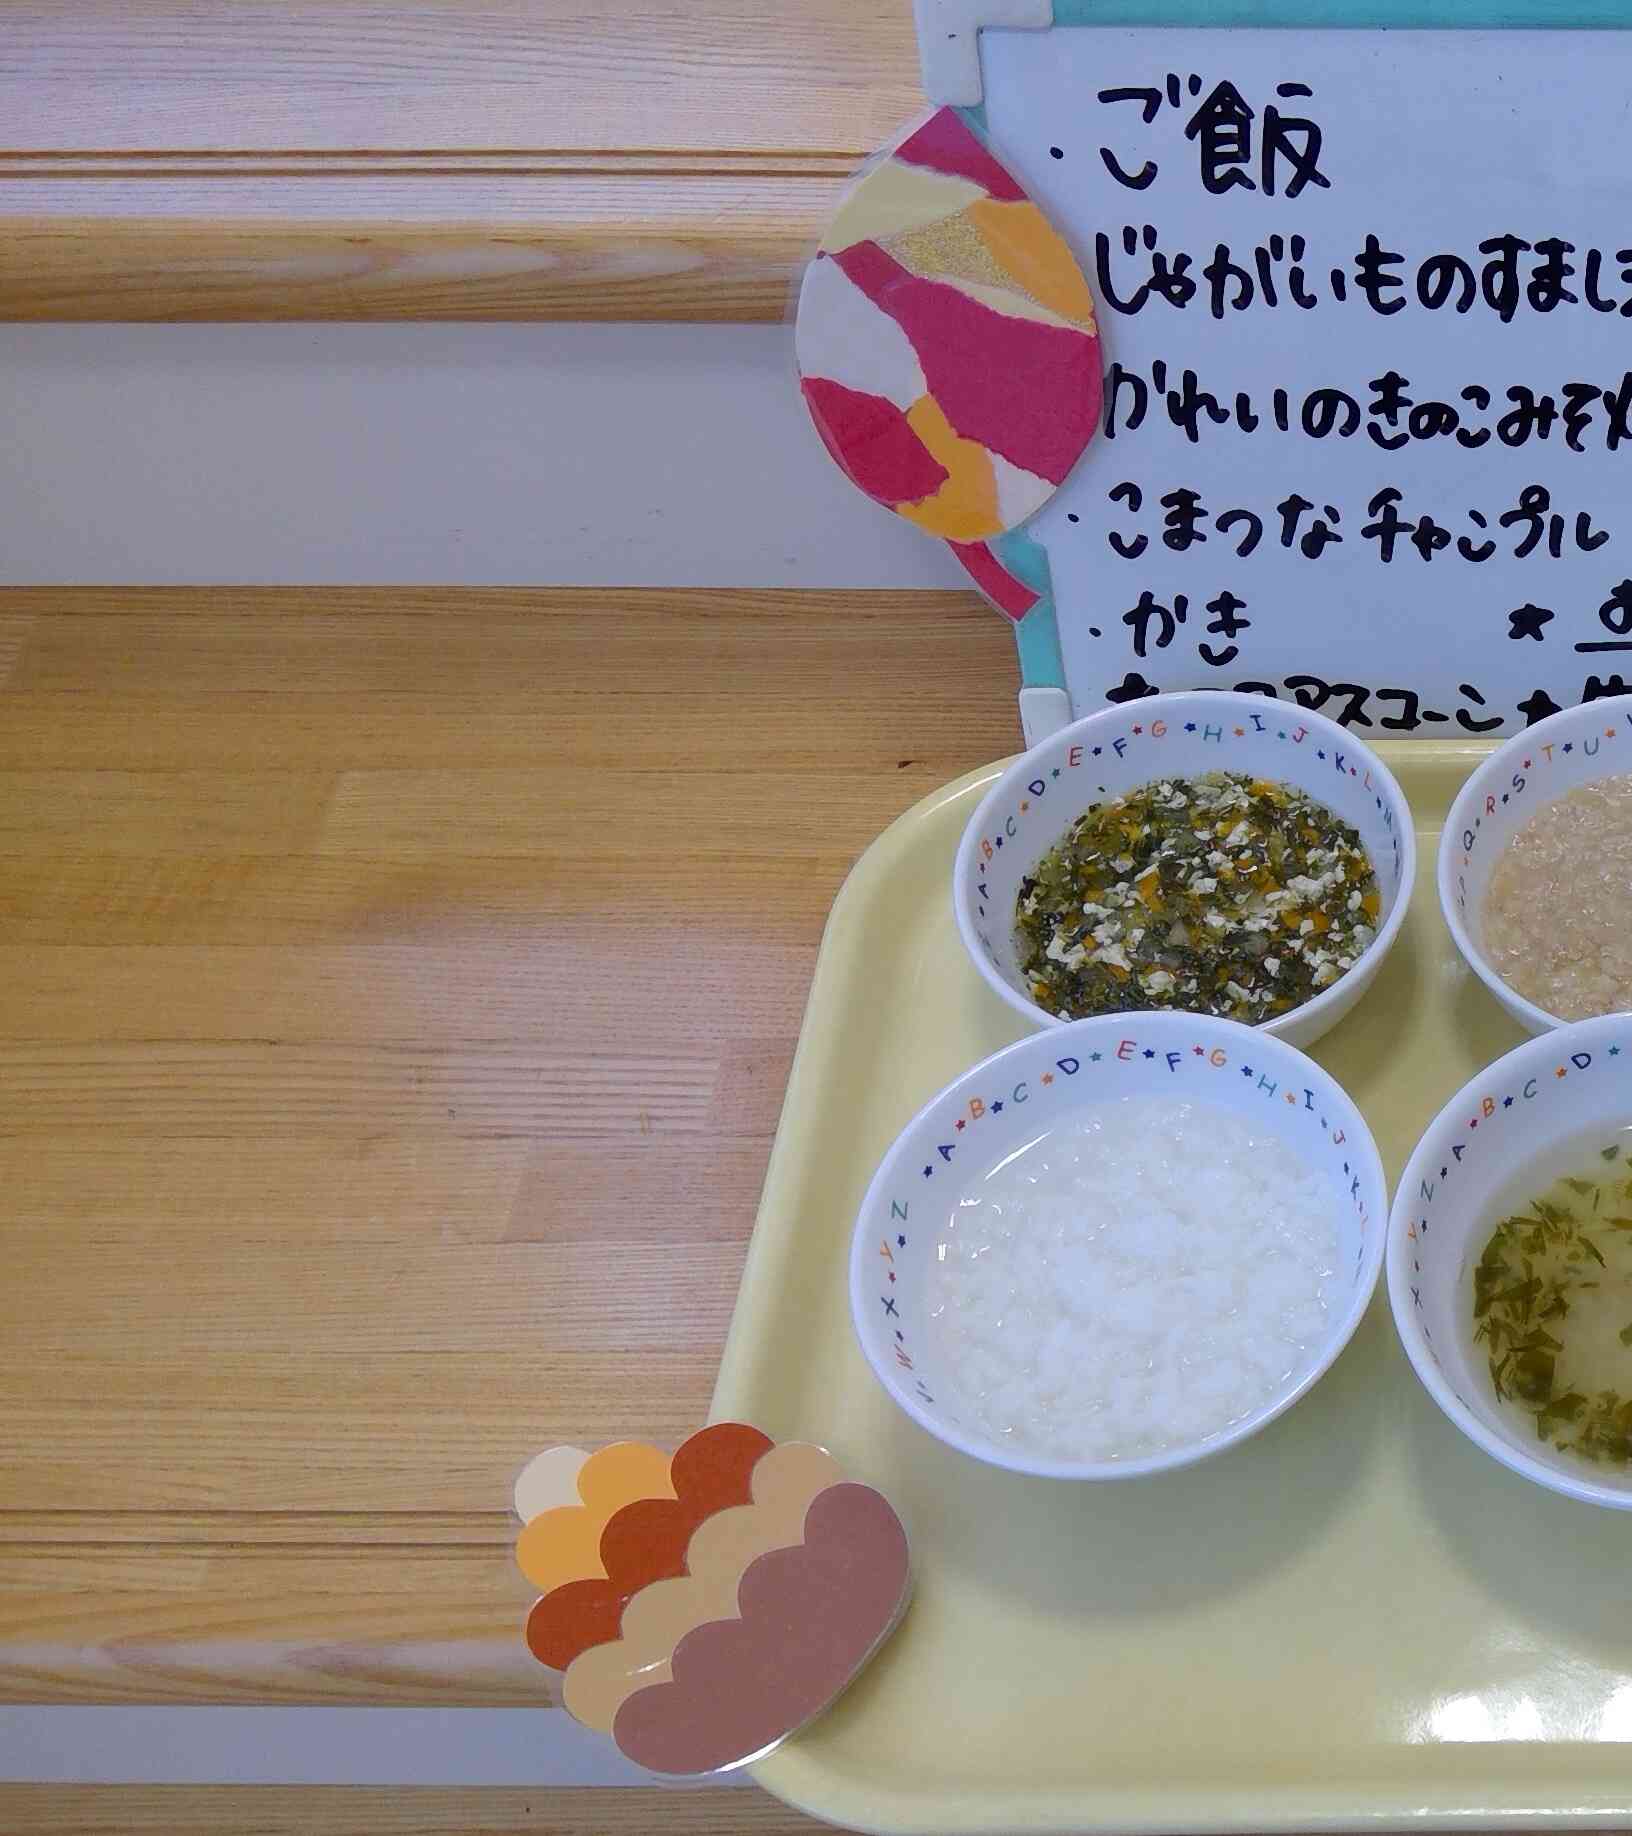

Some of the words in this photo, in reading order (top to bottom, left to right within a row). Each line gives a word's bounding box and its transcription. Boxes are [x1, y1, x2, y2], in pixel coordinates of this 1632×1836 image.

[1097, 73, 1332, 199] ご飯
[1122, 590, 1251, 667] かき
[1184, 675, 1505, 733] アスコーン
[1151, 719, 1169, 738] G
[1202, 724, 1223, 743] H
[1249, 714, 1267, 732] I
[1292, 726, 1310, 744] J
[1069, 746, 1084, 768] E
[1112, 737, 1128, 759] F
[1335, 751, 1347, 774] K
[1027, 779, 1046, 797] D
[1463, 829, 1476, 852] Q
[1486, 795, 1496, 816] R
[1511, 773, 1526, 793] S
[1540, 743, 1555, 762] T
[1583, 736, 1600, 757] U
[1005, 815, 1017, 838] C
[981, 839, 994, 861] B
[977, 883, 990, 900] A
[1451, 1144, 1466, 1163] A
[1481, 1096, 1496, 1119] B
[1522, 1078, 1537, 1100] C
[1570, 1052, 1592, 1070] D
[880, 1296, 900, 1318] X
[937, 1144, 956, 1162] A
[968, 1097, 986, 1121] B
[1012, 1081, 1029, 1104] C
[1055, 1057, 1080, 1076] D
[1116, 1039, 1137, 1061] E
[1165, 1051, 1182, 1073] F
[1207, 1047, 1228, 1068] G
[1256, 1073, 1278, 1098] H
[1303, 1088, 1315, 1112] I
[1332, 1129, 1347, 1145] J
